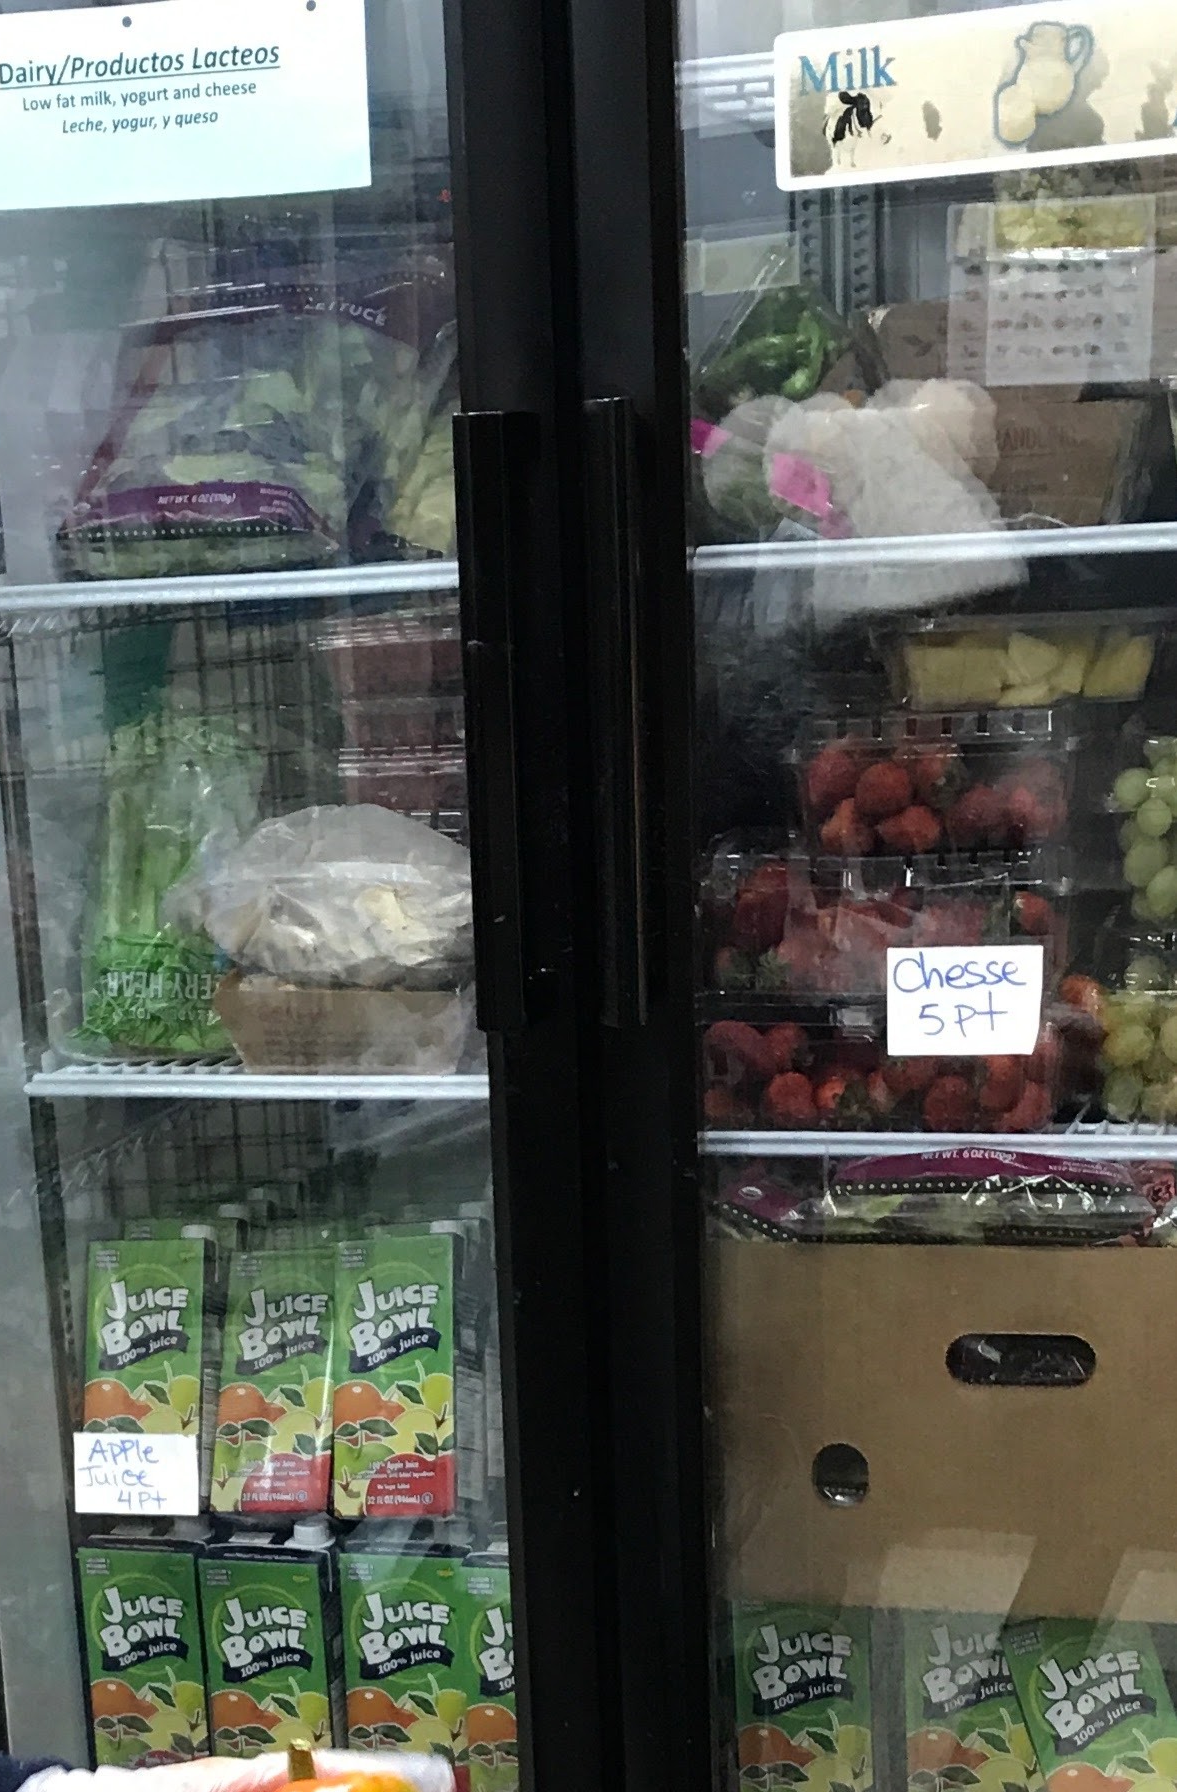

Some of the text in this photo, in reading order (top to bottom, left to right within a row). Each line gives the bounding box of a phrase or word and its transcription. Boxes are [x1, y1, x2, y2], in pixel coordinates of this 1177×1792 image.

[192, 43, 280, 69] Lacteos
[798, 45, 897, 96] Milk
[22, 79, 257, 112] Low fat milk, yogurt and cheese
[62, 109, 219, 135] Leche, yogur, y queso
[174, 973, 221, 1001] ERY
[893, 951, 1027, 993] Chesse
[919, 1003, 945, 1036] 5
[106, 1280, 189, 1320] JUICE
[245, 1288, 329, 1326] JUICE
[353, 1280, 440, 1320] JUICE
[101, 1310, 183, 1355] BOWL
[149, 1335, 178, 1353] juice
[238, 1320, 321, 1360] BOWL
[285, 1339, 315, 1359] juice
[349, 1306, 434, 1359] BOWL
[399, 1332, 430, 1353] juice
[78, 1465, 154, 1487] Juice
[118, 1489, 132, 1511] 4
[101, 1586, 184, 1624] JUICE
[221, 1597, 308, 1635] JUICE
[362, 1592, 451, 1630] JUICE
[99, 1617, 181, 1657] BOWL
[148, 1641, 177, 1659] juice
[221, 1628, 305, 1668] BOWL
[358, 1623, 446, 1665] BOWL
[756, 1624, 852, 1664] JUICE
[928, 1625, 1001, 1666] JUIC
[270, 1652, 301, 1669] juice
[409, 1648, 441, 1667] juice
[1038, 1650, 1141, 1701] JUICE
[752, 1656, 847, 1700] BOWL
[808, 1681, 841, 1697] juice
[980, 1680, 1014, 1700] juice
[1043, 1673, 1144, 1740] BOWL
[1106, 1700, 1142, 1726] juice
